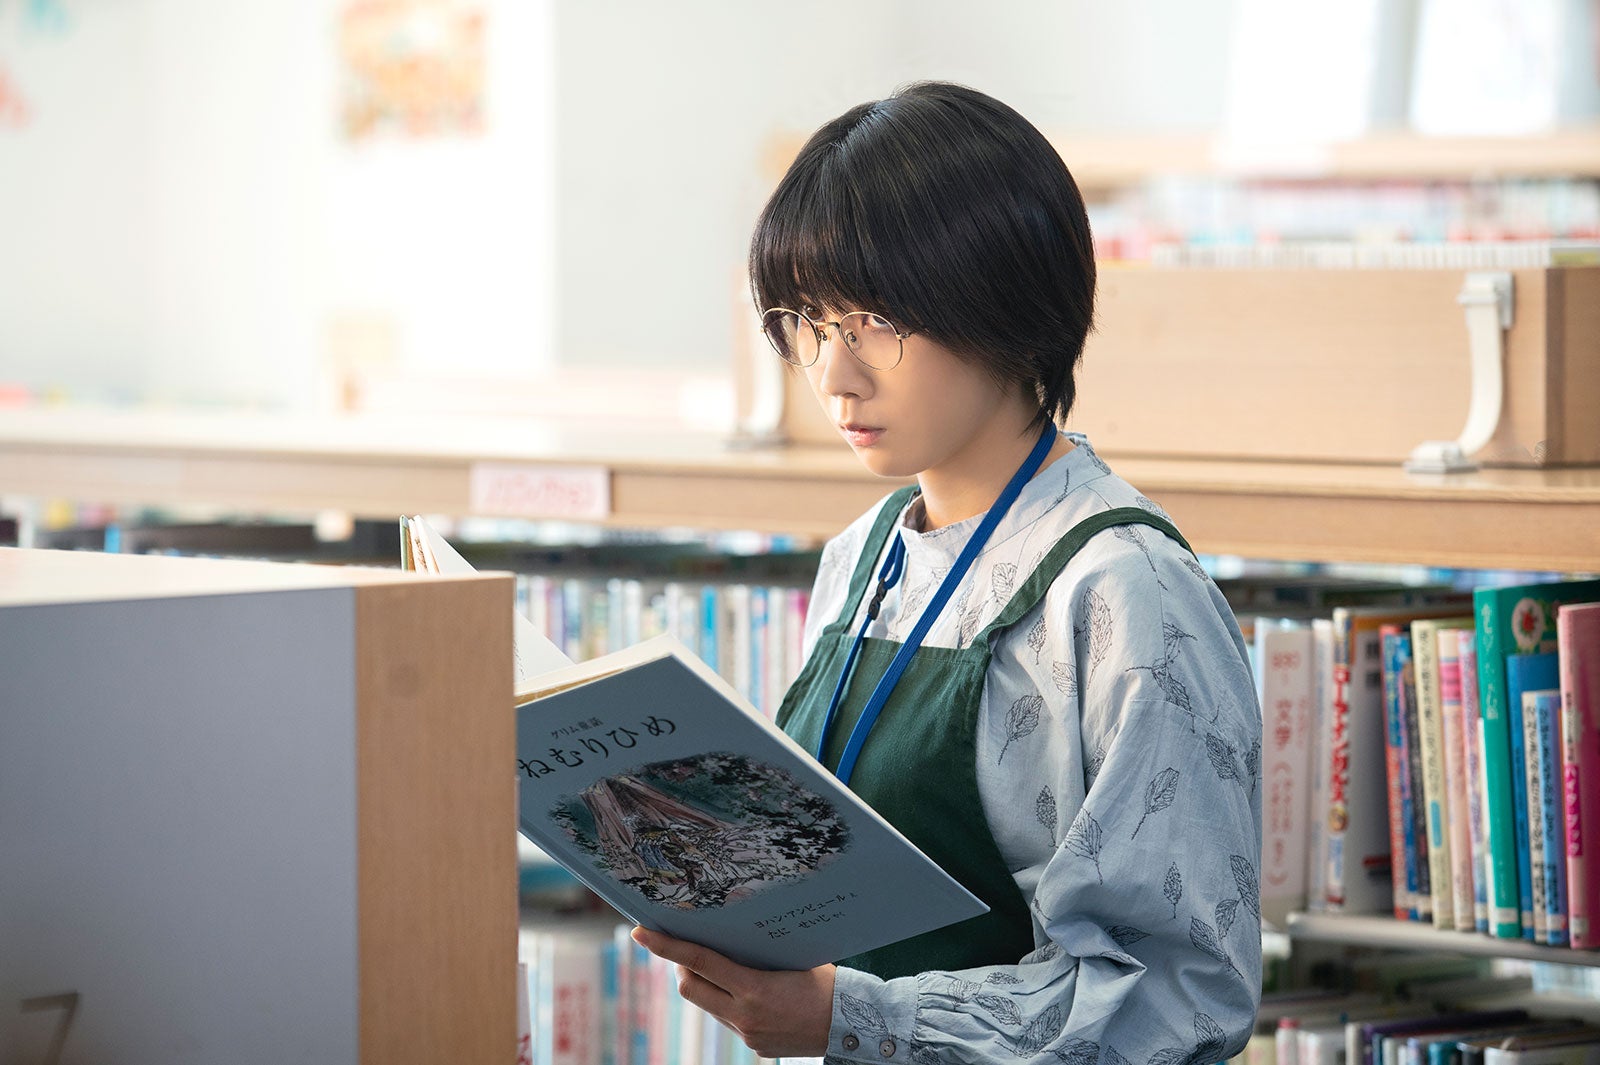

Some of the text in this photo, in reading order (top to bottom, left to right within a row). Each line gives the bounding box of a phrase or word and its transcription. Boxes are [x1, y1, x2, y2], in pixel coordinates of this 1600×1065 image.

[517, 716, 676, 778] ねむりひめ
